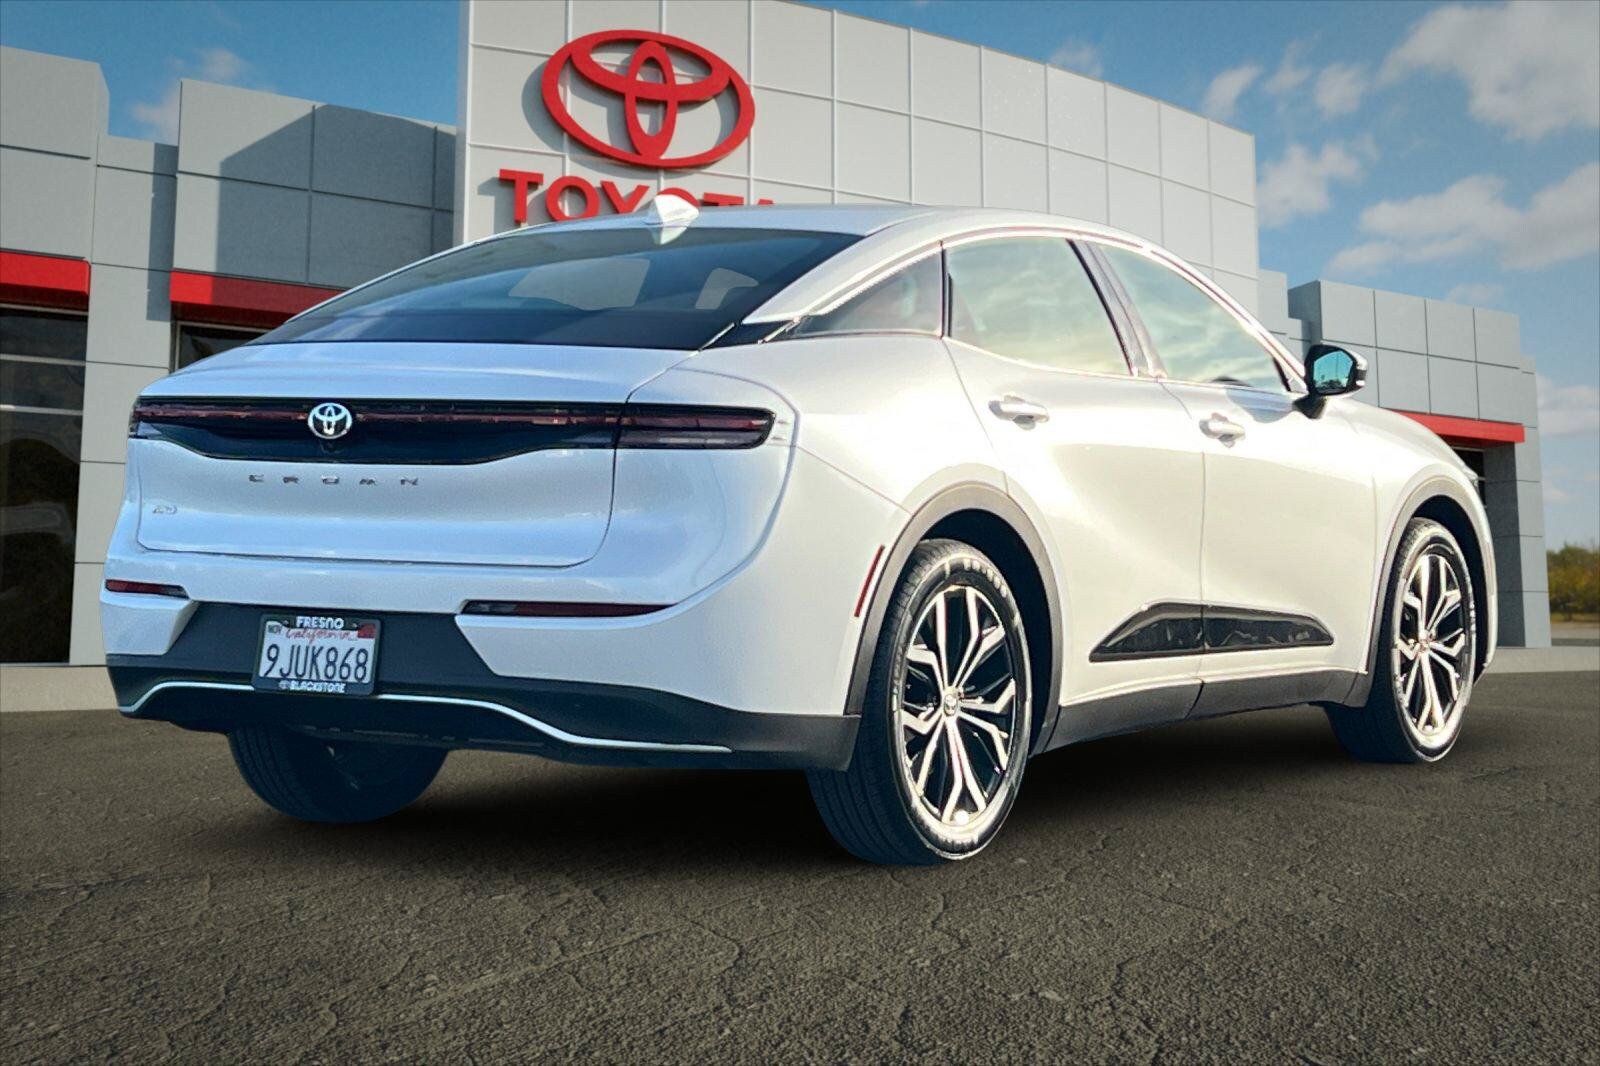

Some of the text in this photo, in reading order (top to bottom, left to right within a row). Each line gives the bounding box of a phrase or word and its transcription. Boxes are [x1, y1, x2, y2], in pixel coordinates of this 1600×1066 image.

[499, 168, 775, 224] TOY
[296, 616, 345, 629] FRESNO
[263, 643, 369, 682] 9JUK868
